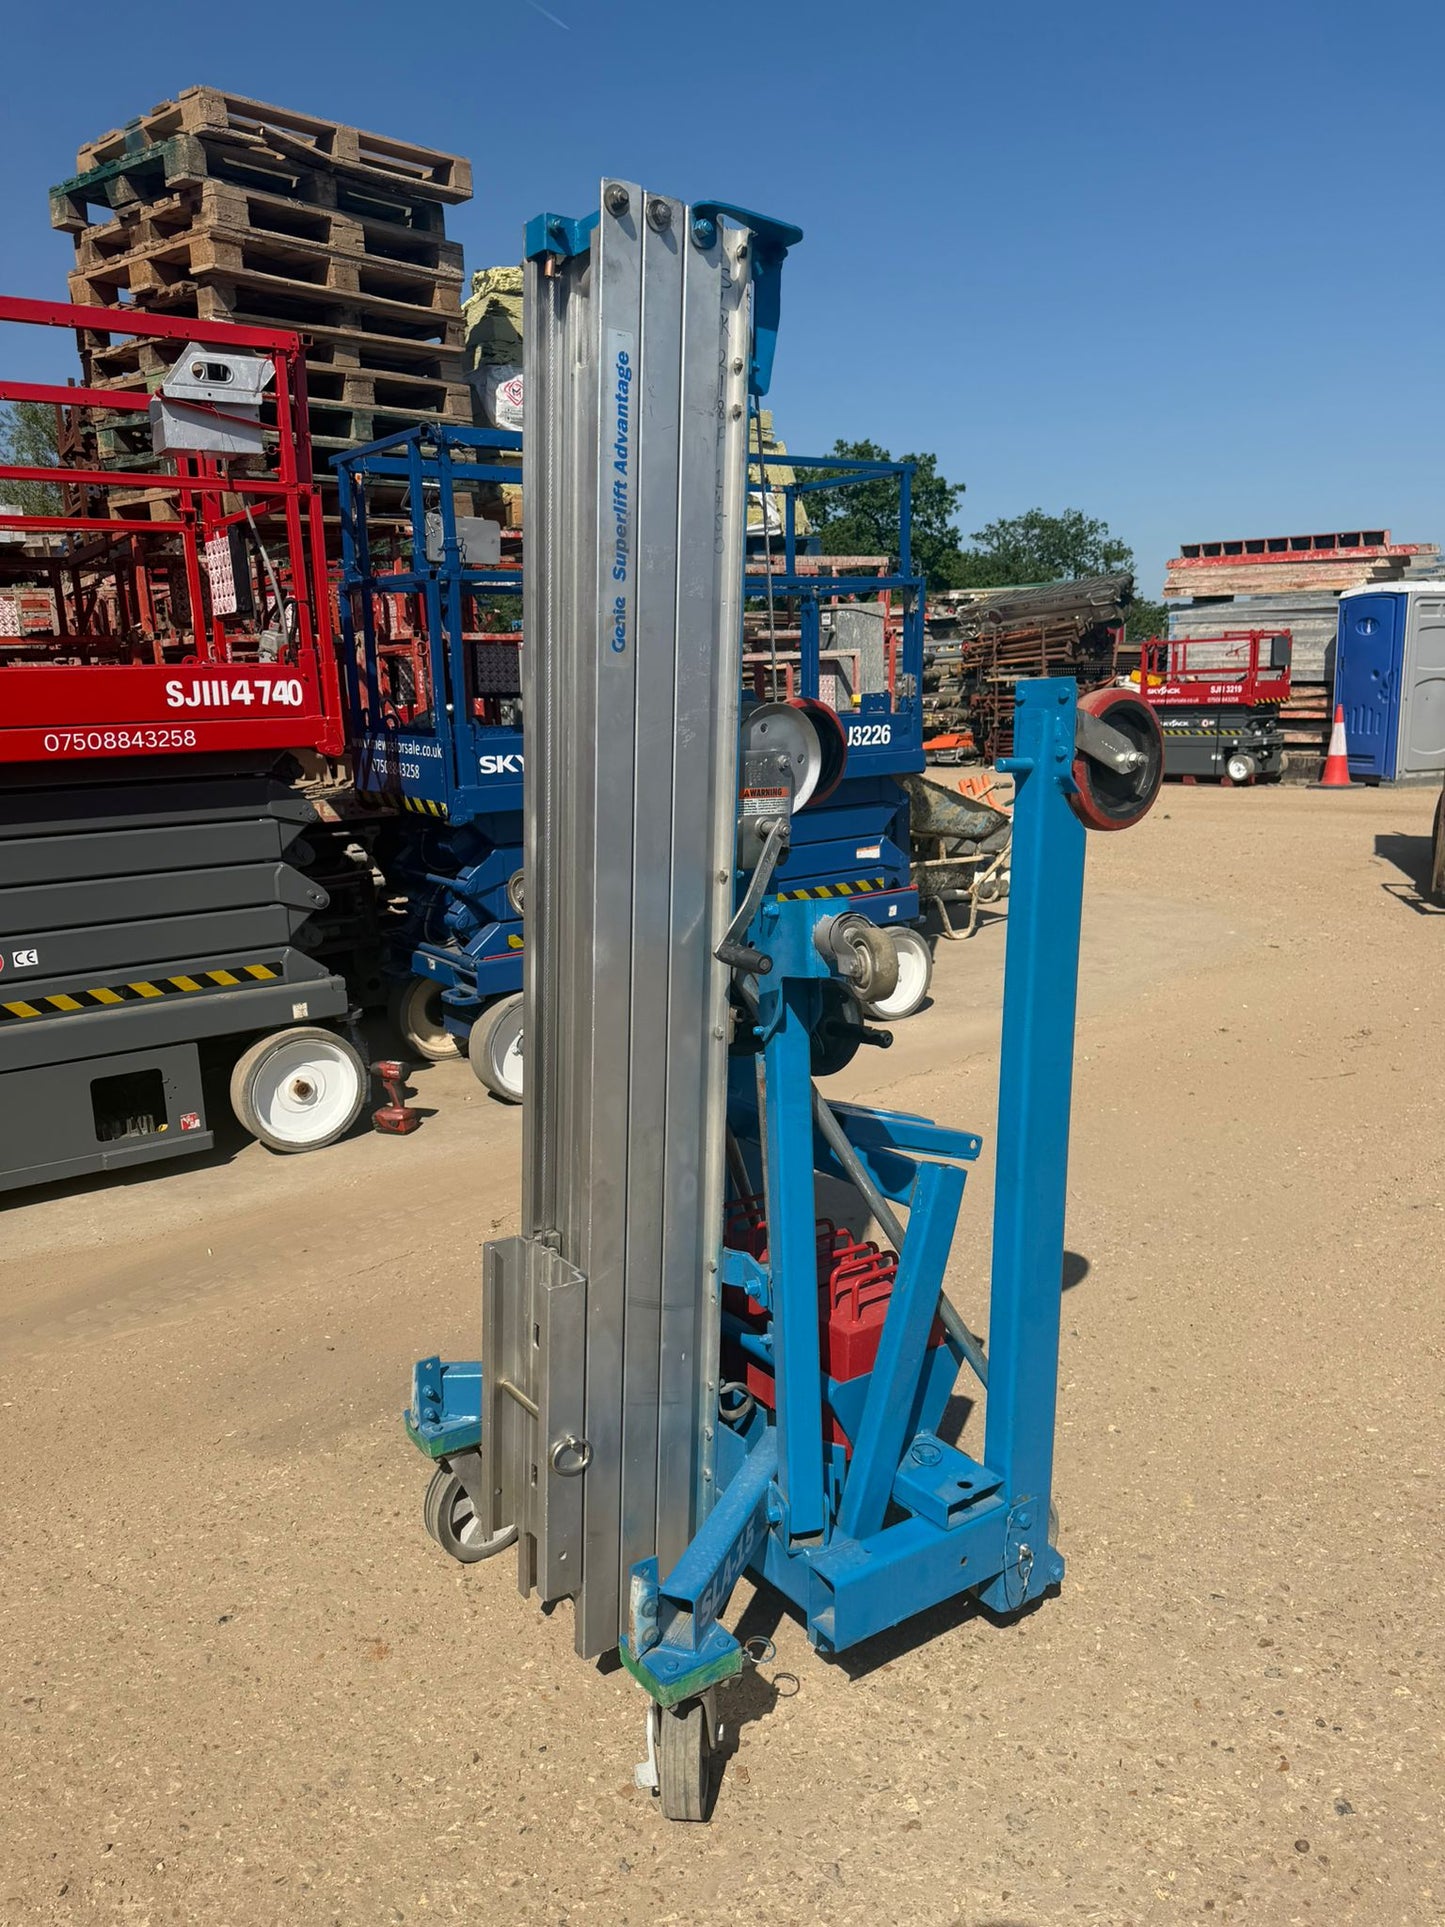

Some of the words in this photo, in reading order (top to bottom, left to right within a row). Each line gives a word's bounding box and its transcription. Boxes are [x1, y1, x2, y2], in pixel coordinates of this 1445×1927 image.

[612, 350, 632, 476] Advantage
[611, 480, 630, 582] Superlift
[611, 595, 626, 653] Genie
[165, 679, 303, 707] SJIII4740
[44, 729, 197, 752] 07508843258
[750, 787, 783, 797] WARNING
[15, 950, 36, 965] CE
[700, 1515, 756, 1628] SLA-15
